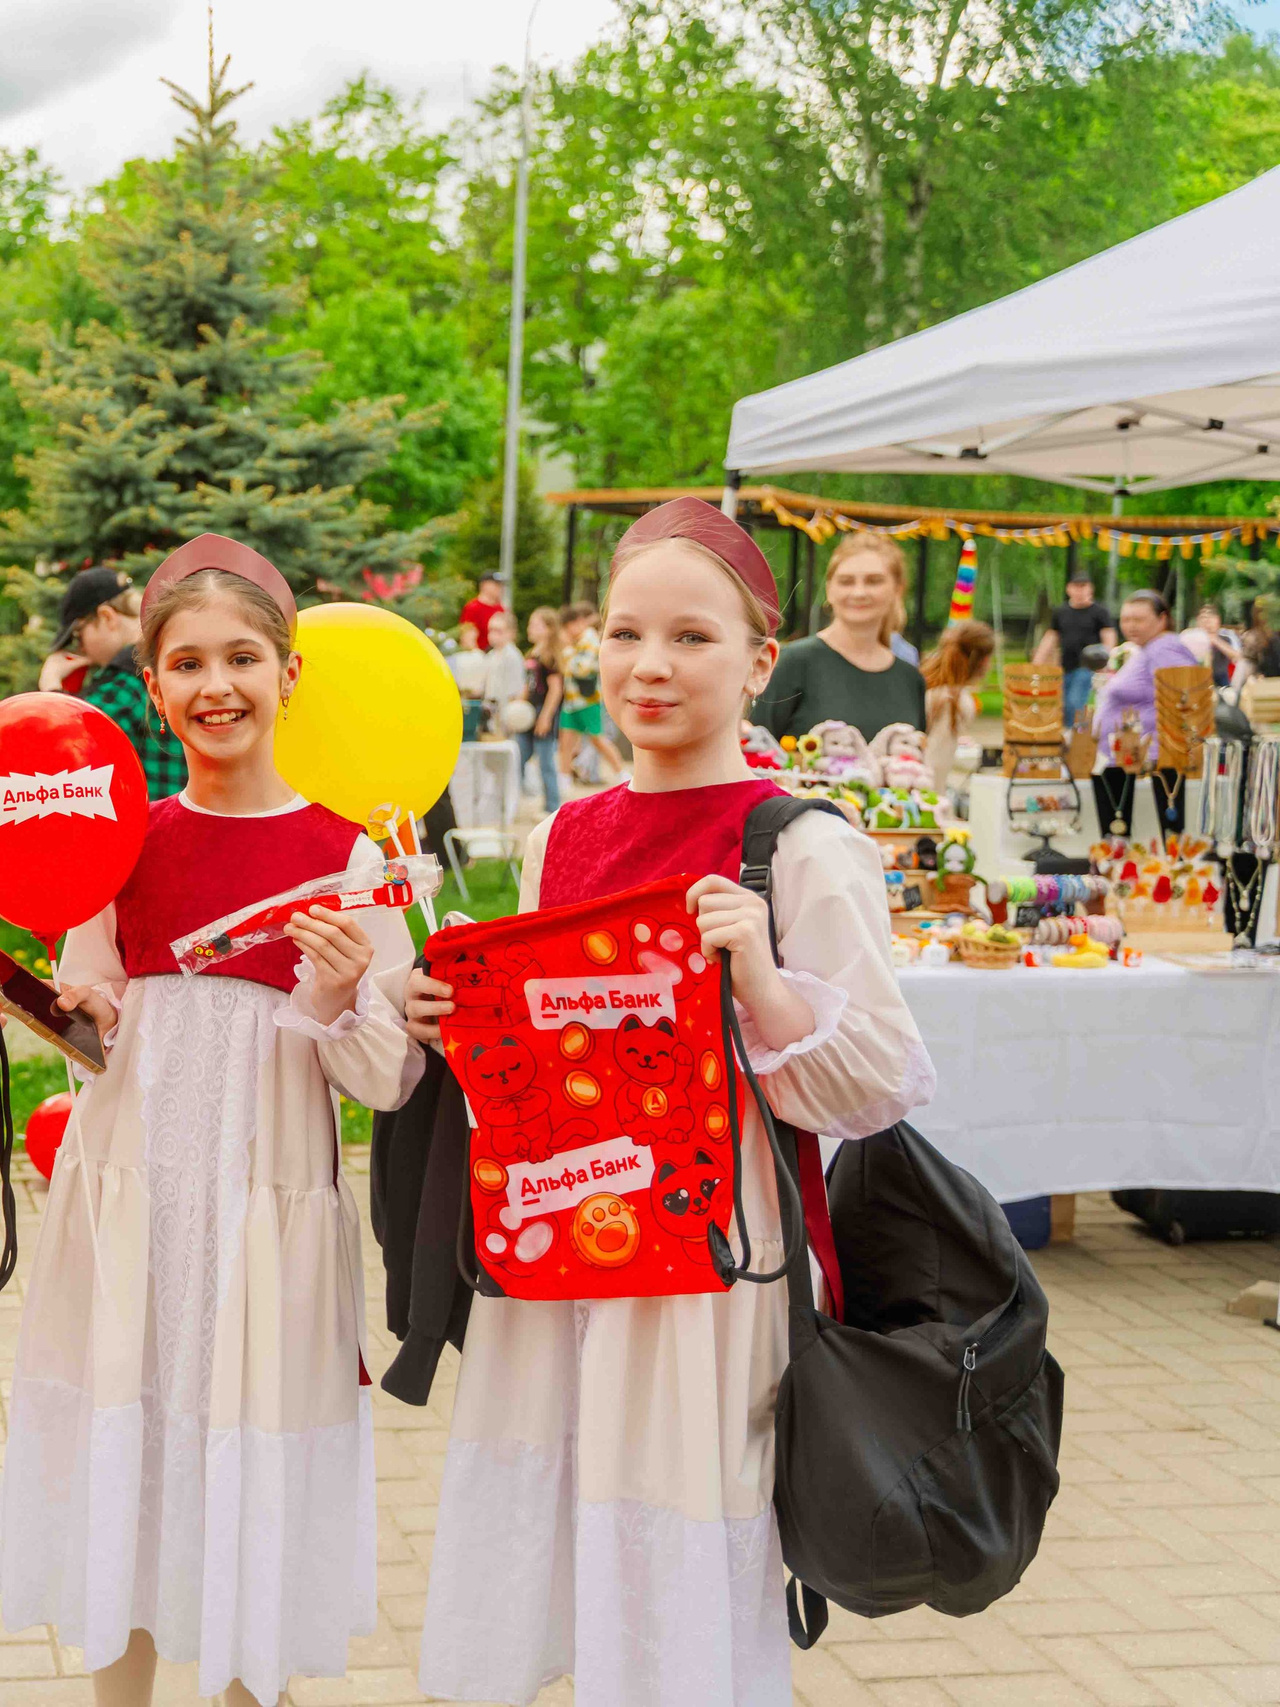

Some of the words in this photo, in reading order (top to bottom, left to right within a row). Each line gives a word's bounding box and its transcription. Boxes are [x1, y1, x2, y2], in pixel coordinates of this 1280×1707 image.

[3, 785, 59, 811] Альфа
[63, 783, 103, 798] Банк
[540, 991, 607, 1018] Альфа
[608, 990, 662, 1009] Банк
[521, 1167, 589, 1206] Альфа
[590, 1154, 642, 1180] Банк
